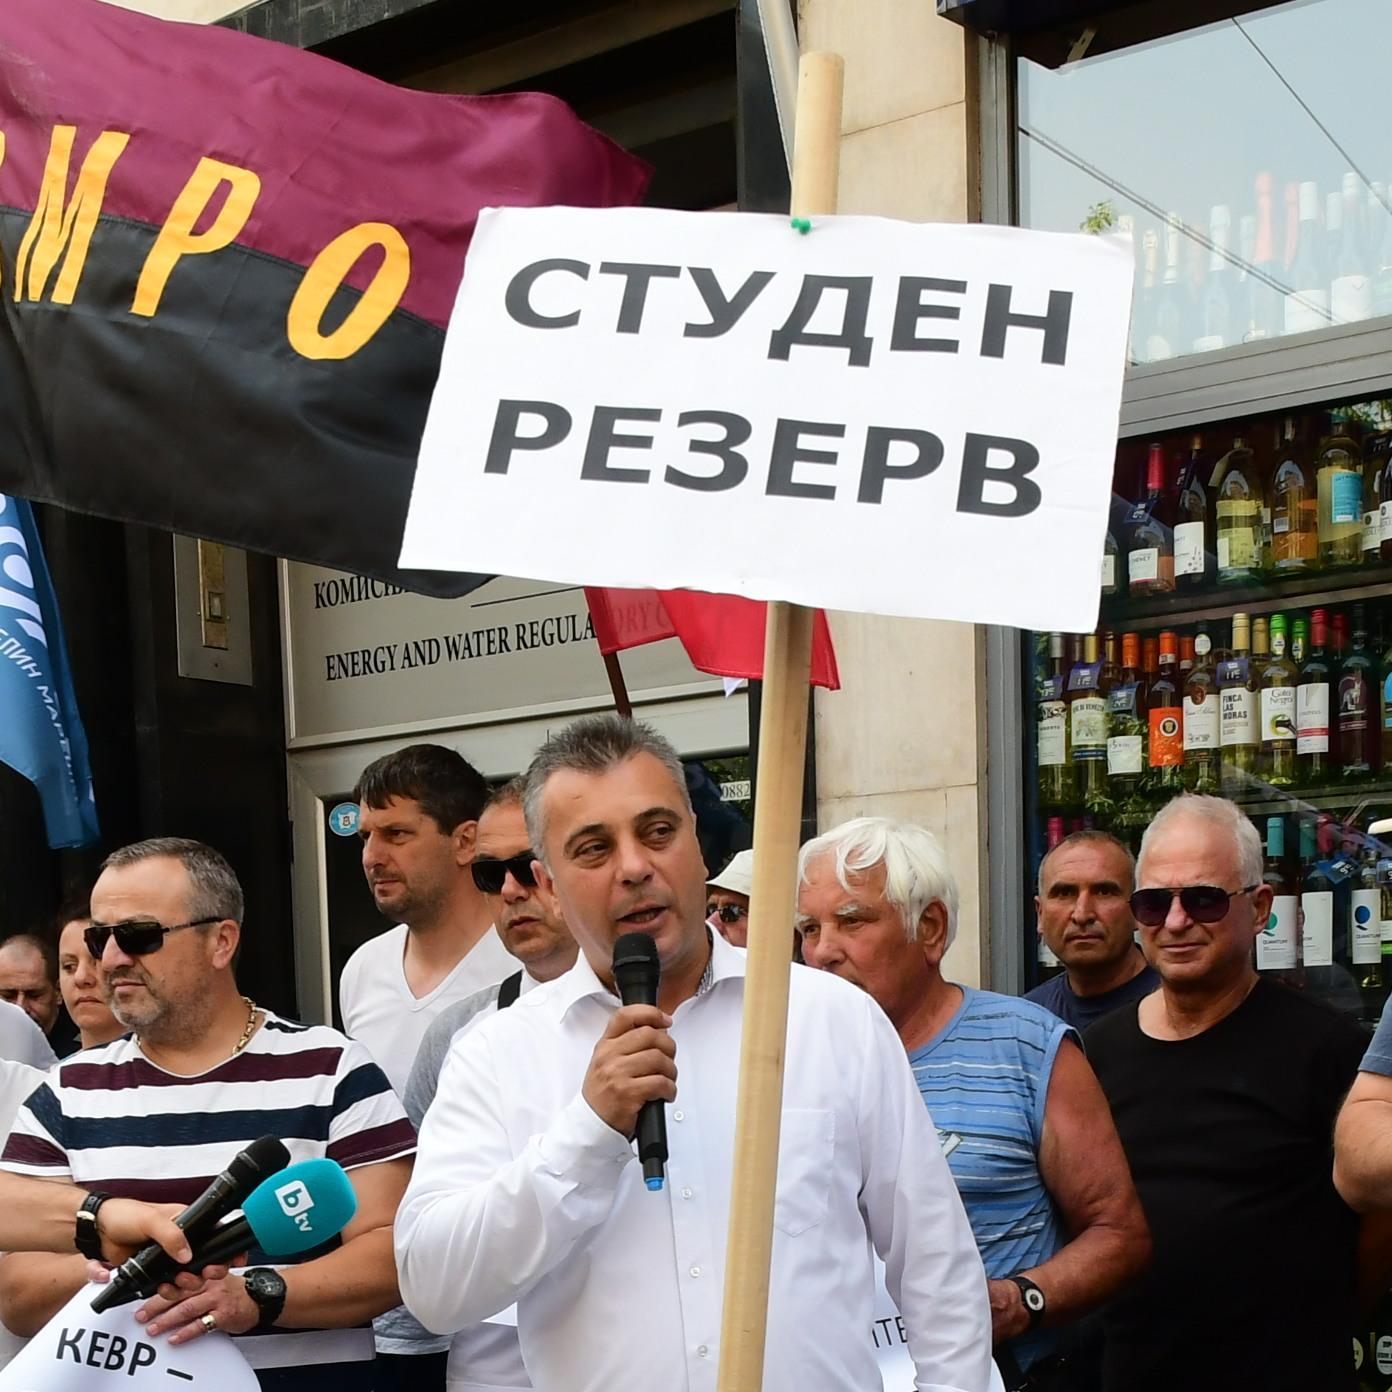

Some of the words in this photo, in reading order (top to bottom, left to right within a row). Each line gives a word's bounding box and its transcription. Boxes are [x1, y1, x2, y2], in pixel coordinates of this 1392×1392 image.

[504, 258, 1074, 369] СТУДЕН
[483, 399, 1044, 518] РЕЗЕРВ
[314, 575, 407, 609] КОМИС
[325, 649, 397, 681] ENERGY
[400, 639, 441, 670] AND
[443, 625, 511, 664] WATER
[1223, 694, 1242, 703] FINCA
[1223, 704, 1234, 712] LAS
[721, 783, 751, 799] 0882
[56, 1327, 156, 1376] КЕВР
